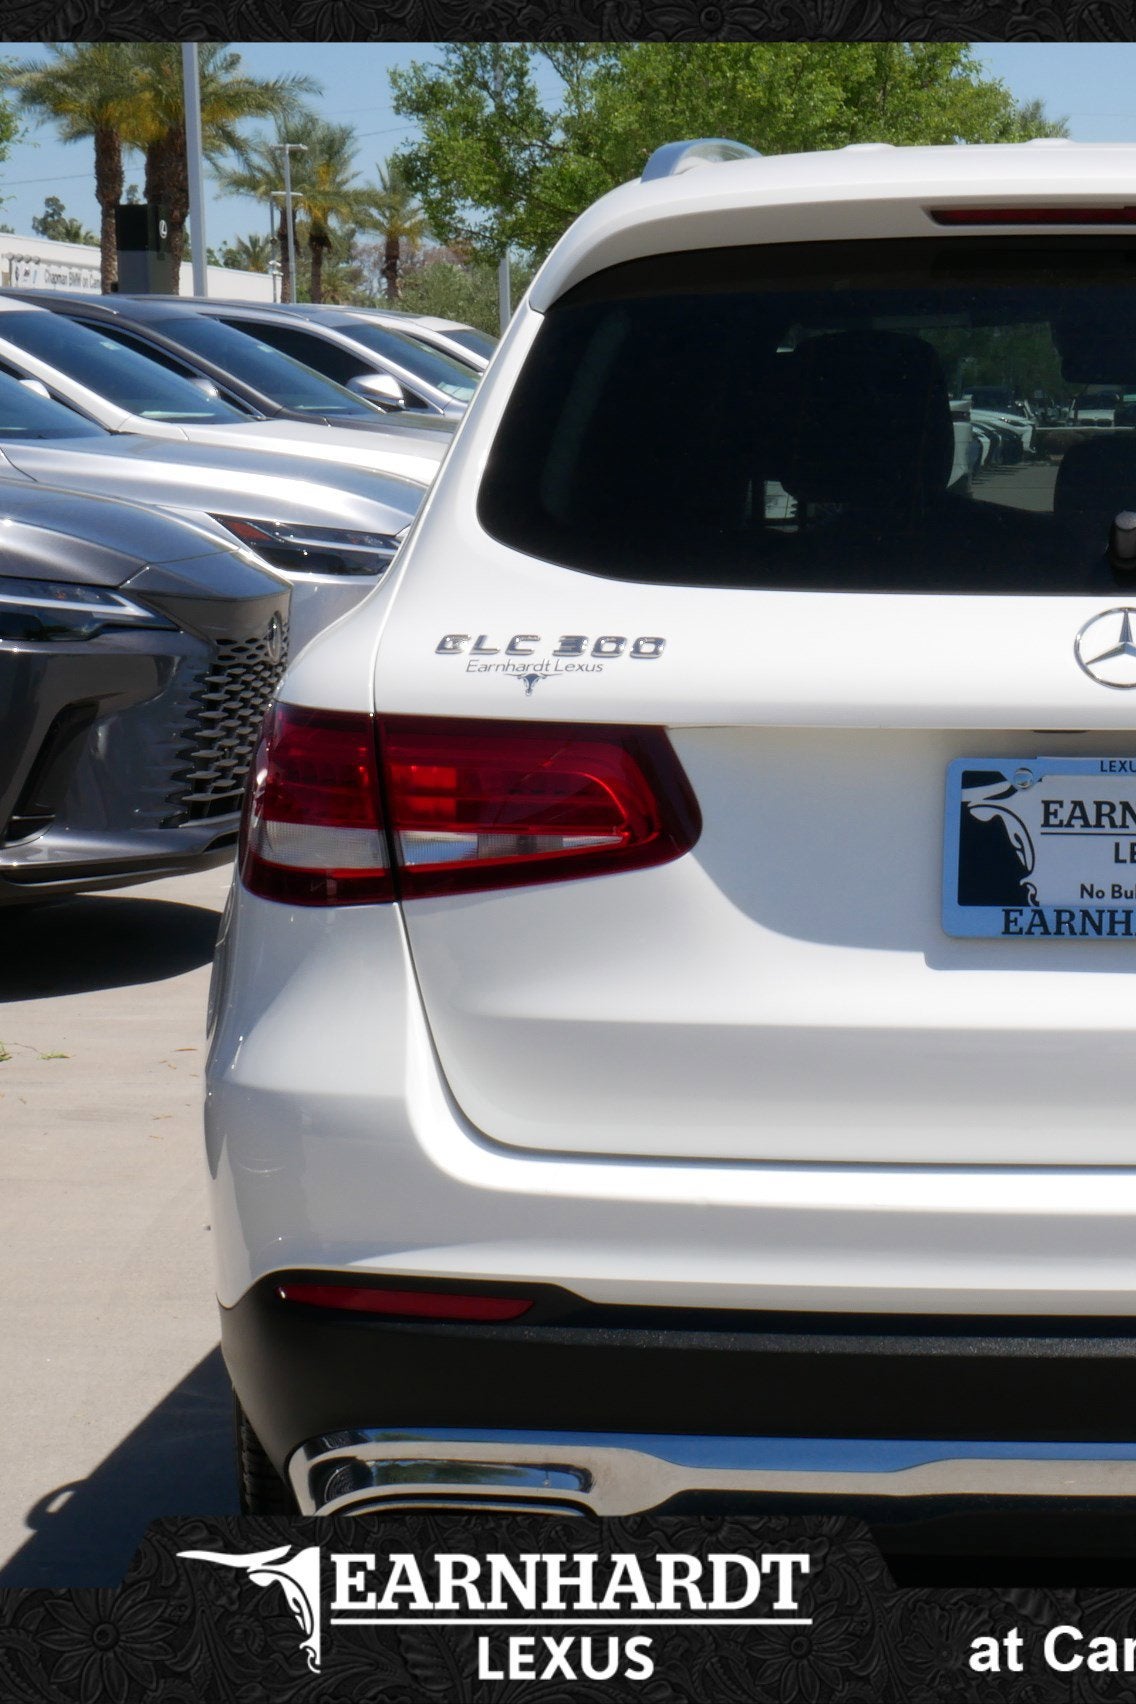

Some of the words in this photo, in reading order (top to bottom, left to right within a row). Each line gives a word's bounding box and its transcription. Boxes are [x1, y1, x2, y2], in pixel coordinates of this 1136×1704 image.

[435, 634, 541, 655] GLC
[552, 635, 667, 660] 300
[466, 658, 551, 674] Earnhardt
[554, 659, 603, 673] Lexus
[1080, 885, 1105, 900] No
